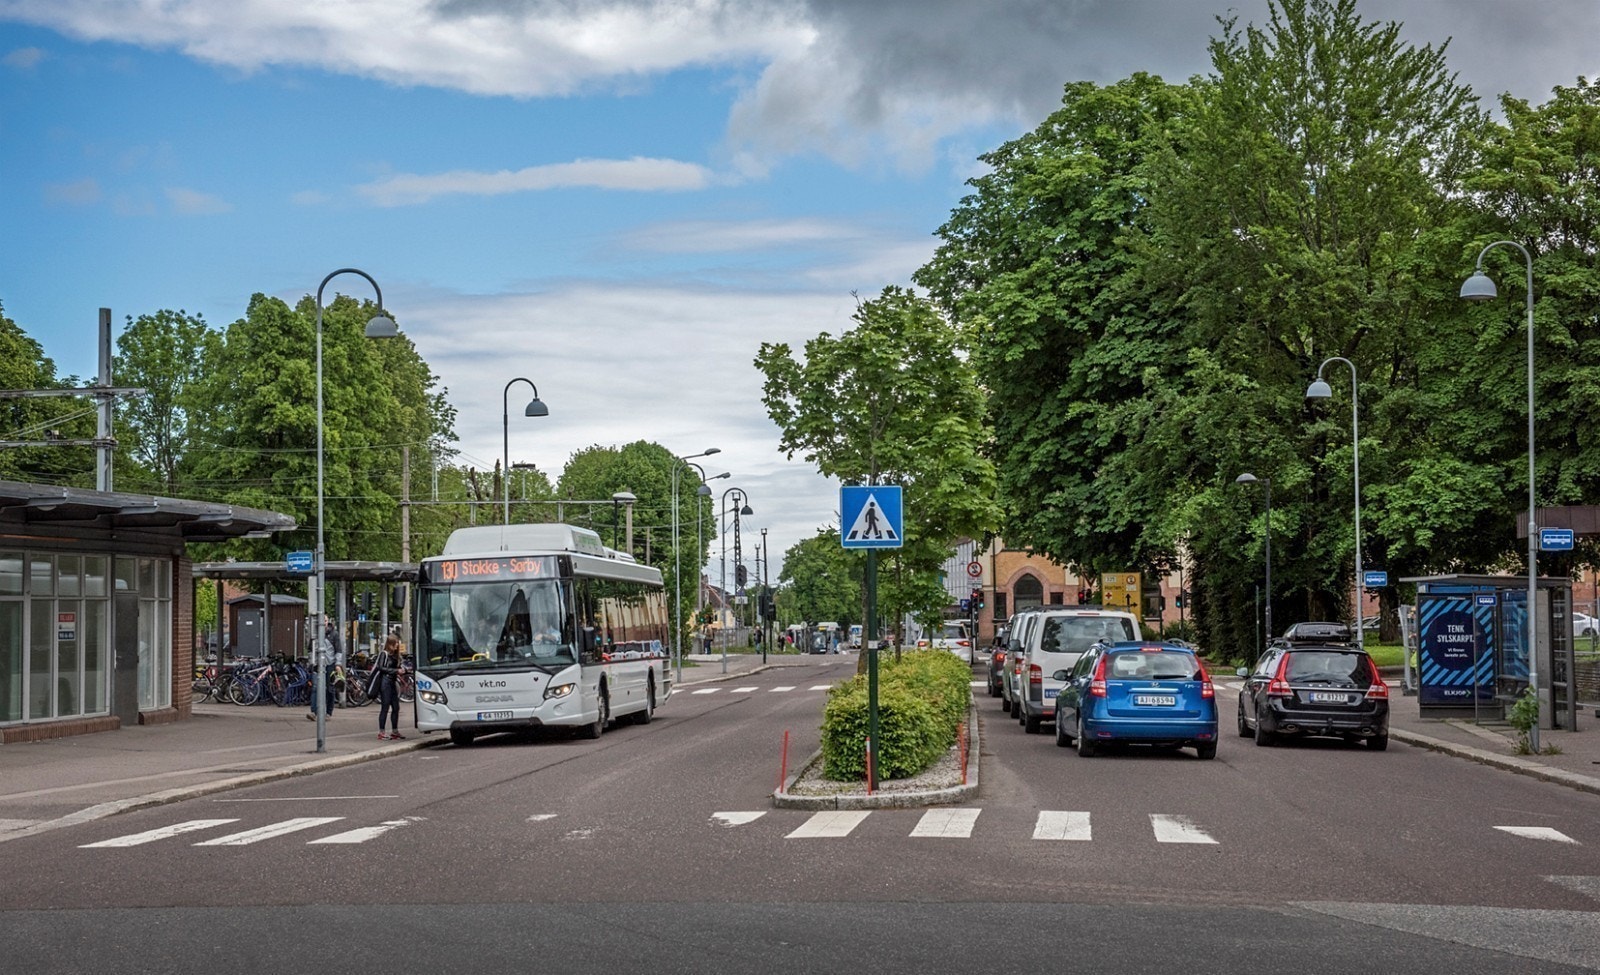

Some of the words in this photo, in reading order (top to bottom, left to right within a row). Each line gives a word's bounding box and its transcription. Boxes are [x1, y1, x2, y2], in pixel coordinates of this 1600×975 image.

[441, 562, 459, 579] 130
[462, 561, 499, 575] Stokke
[510, 558, 540, 575] Sørby
[1447, 624, 1465, 633] TENK
[446, 681, 465, 690] 1930
[479, 679, 507, 689] vkt.no
